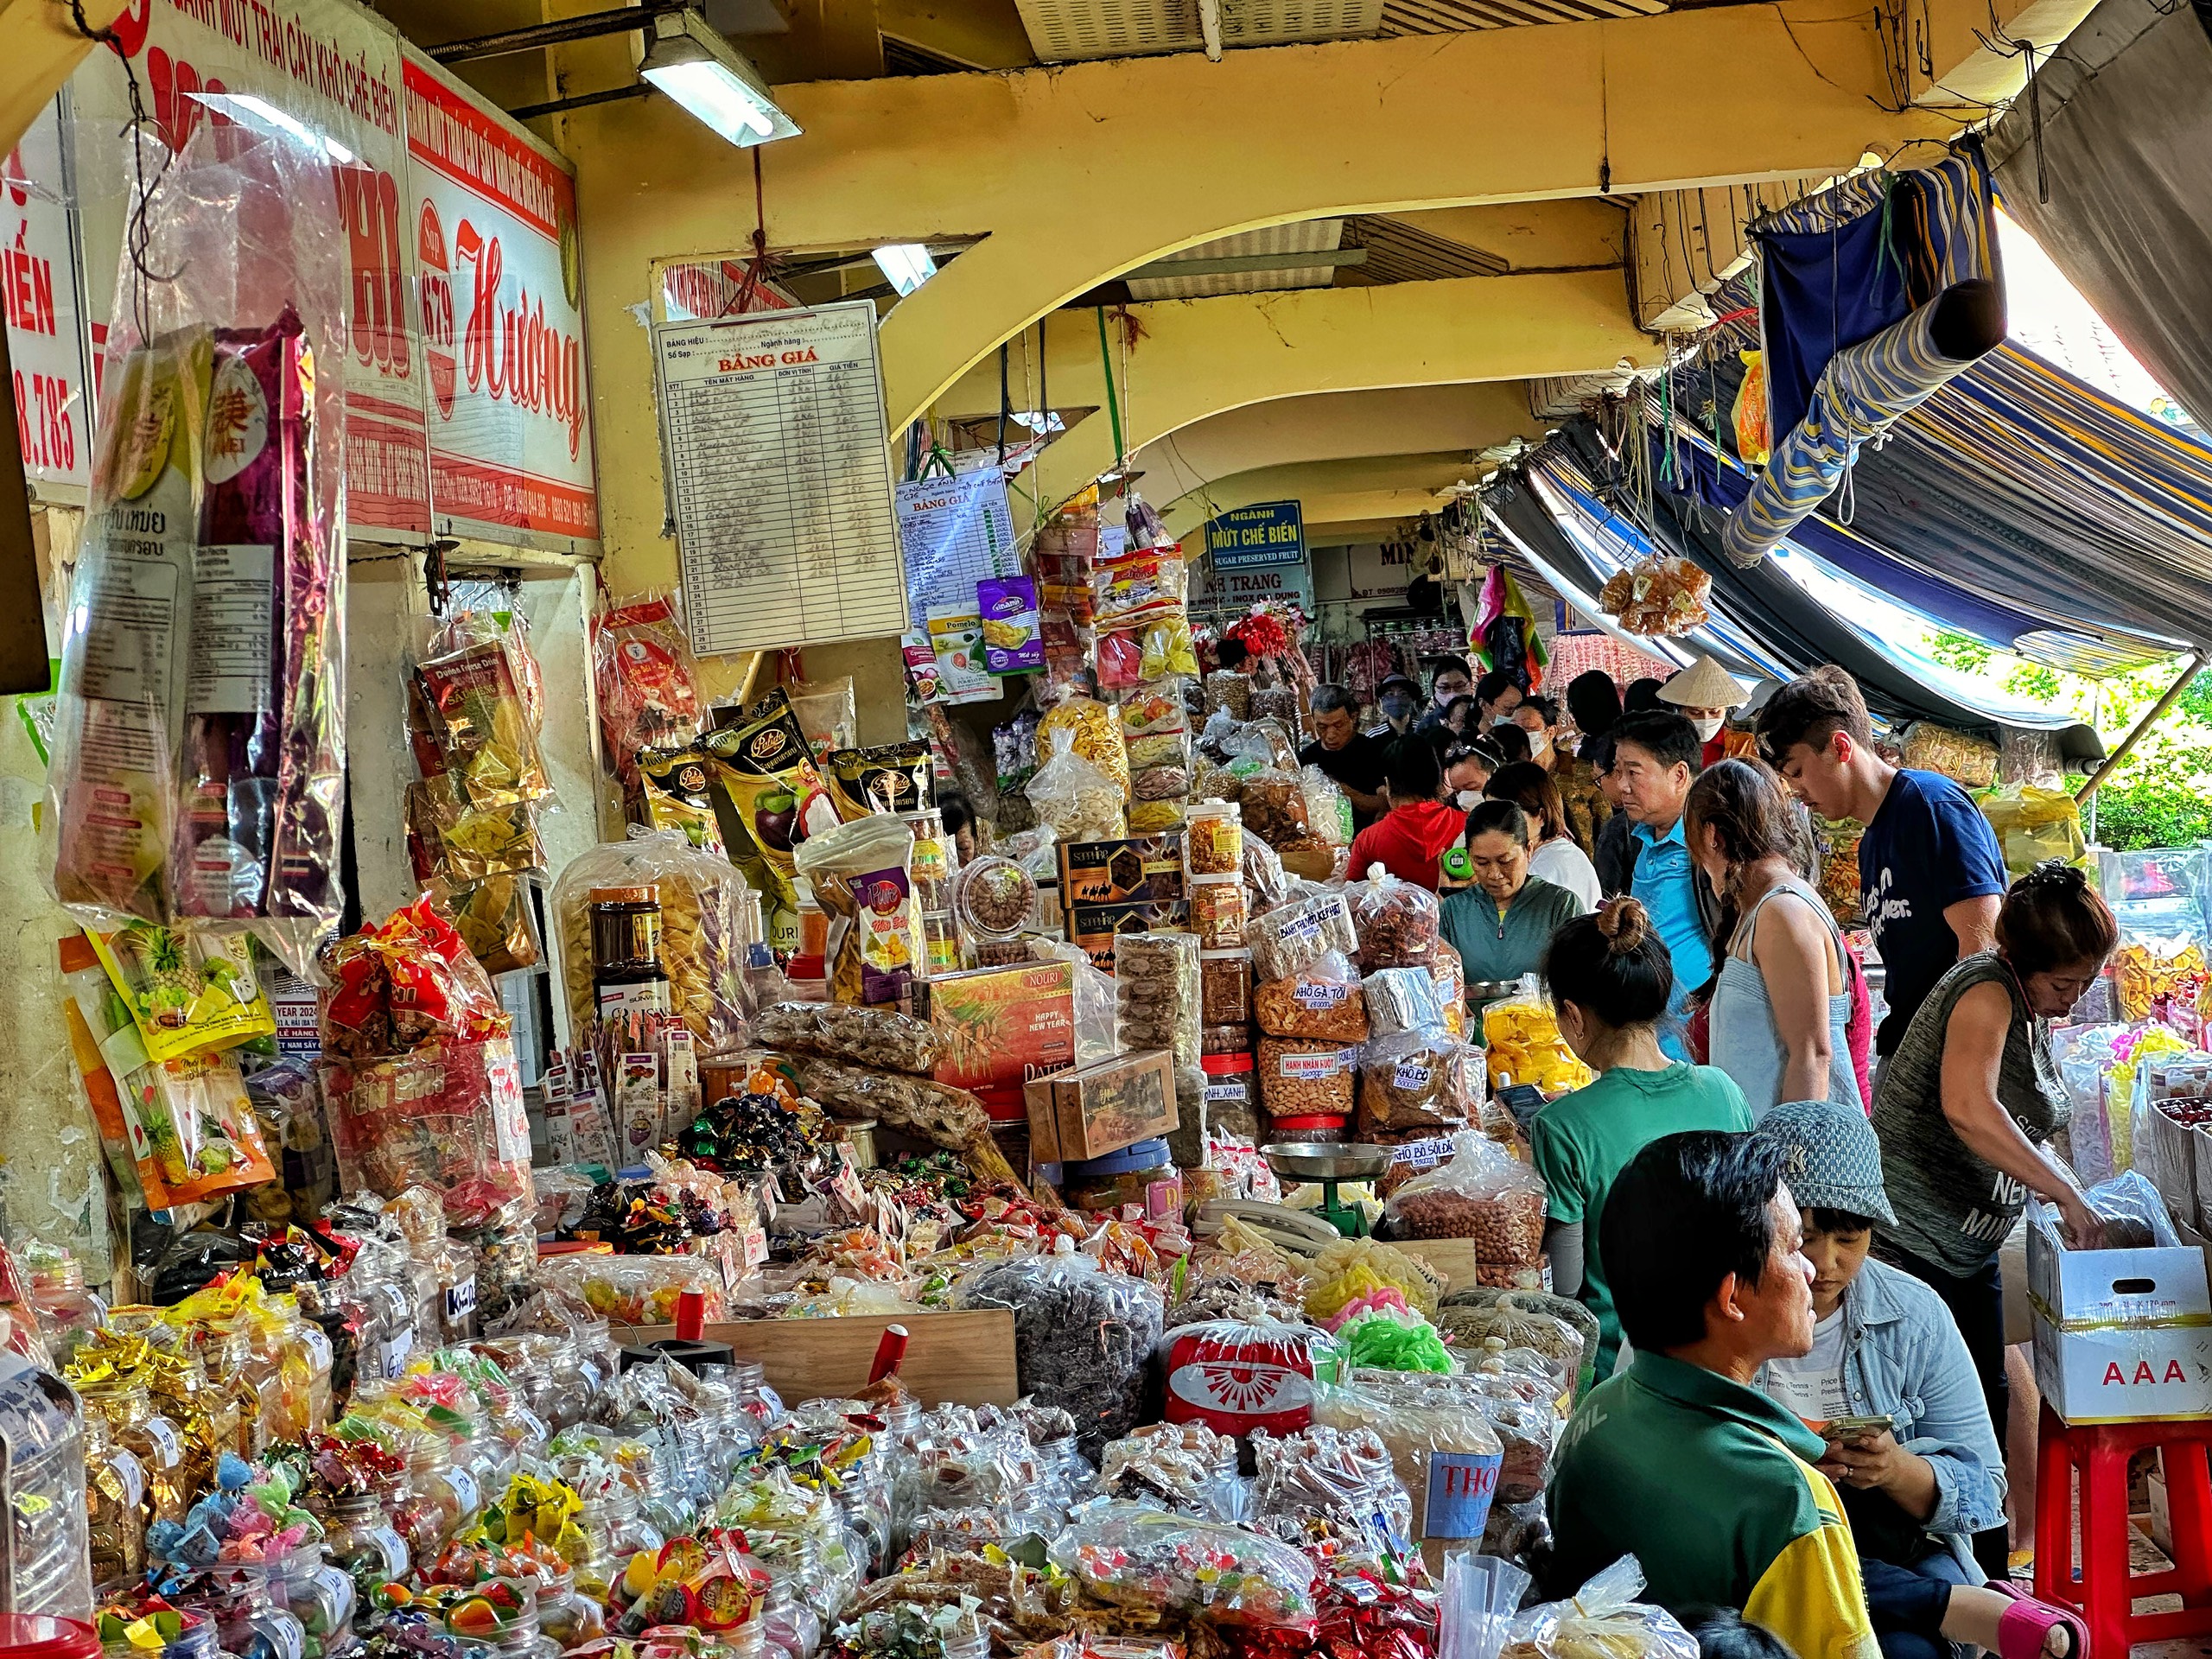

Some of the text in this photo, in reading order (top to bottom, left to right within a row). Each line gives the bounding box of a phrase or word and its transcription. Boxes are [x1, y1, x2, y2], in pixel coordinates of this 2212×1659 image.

[315, 38, 344, 106] KHÔ
[345, 49, 371, 123] CHẾ
[371, 64, 398, 139] BIẾN
[421, 270, 453, 347] 679
[455, 218, 586, 463] Hương
[718, 346, 819, 372] BẢNG GIÁ
[912, 493, 971, 512] BẢNG GIÁ
[1230, 509, 1274, 522] NGÀNH
[1212, 519, 1297, 550] MỨT CHẾ BIẾN
[1214, 550, 1299, 566] SUGAR PRESERVED FRUIT
[1230, 573, 1281, 591] TRANG
[946, 620, 976, 630] Pomelo
[868, 881, 898, 907] Pure
[1029, 972, 1059, 987] NOURI
[277, 1007, 297, 1017] YEAR
[1035, 1010, 1059, 1021] HAPPY
[1029, 1020, 1065, 1032] NEW YEAR
[1286, 1059, 1301, 1072] HẠNH
[1302, 1058, 1319, 1070] NHÂN
[1821, 1377, 1838, 1387] Price
